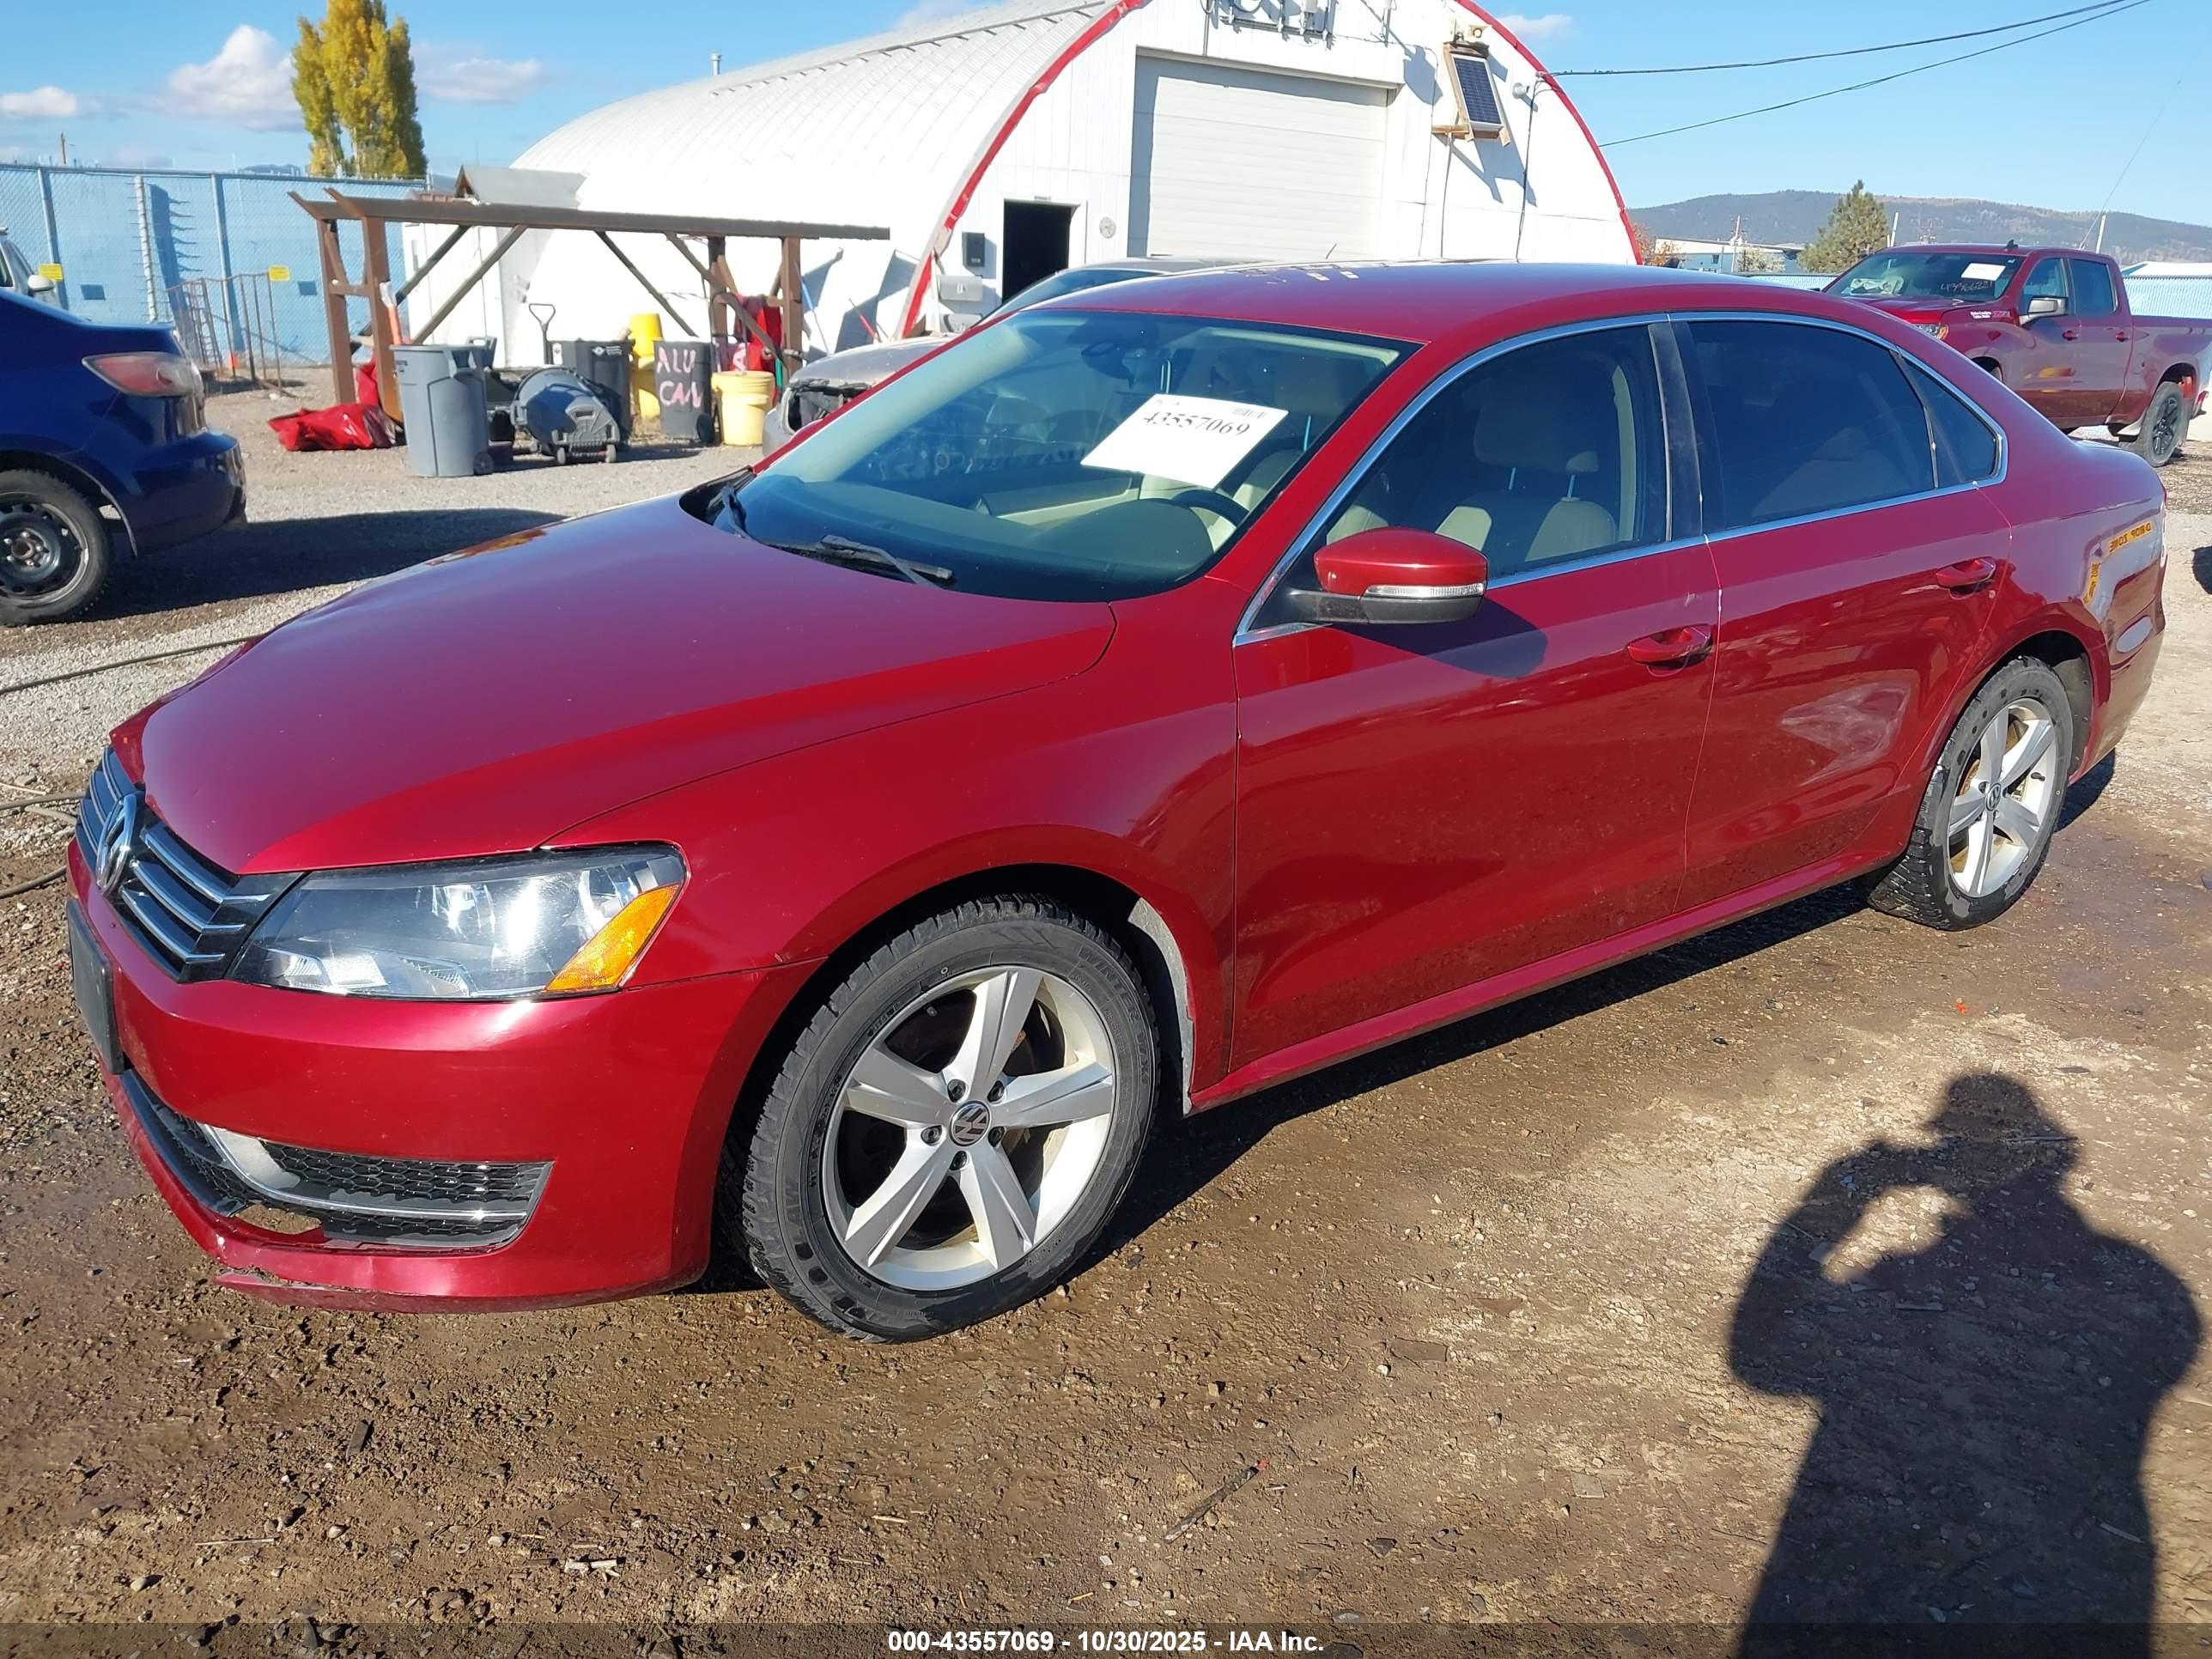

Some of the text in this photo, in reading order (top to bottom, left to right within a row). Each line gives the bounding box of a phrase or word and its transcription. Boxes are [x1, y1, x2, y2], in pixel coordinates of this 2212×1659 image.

[657, 346, 696, 374] ALU
[659, 380, 703, 409] CAN
[1143, 412, 1251, 435] 43557069
